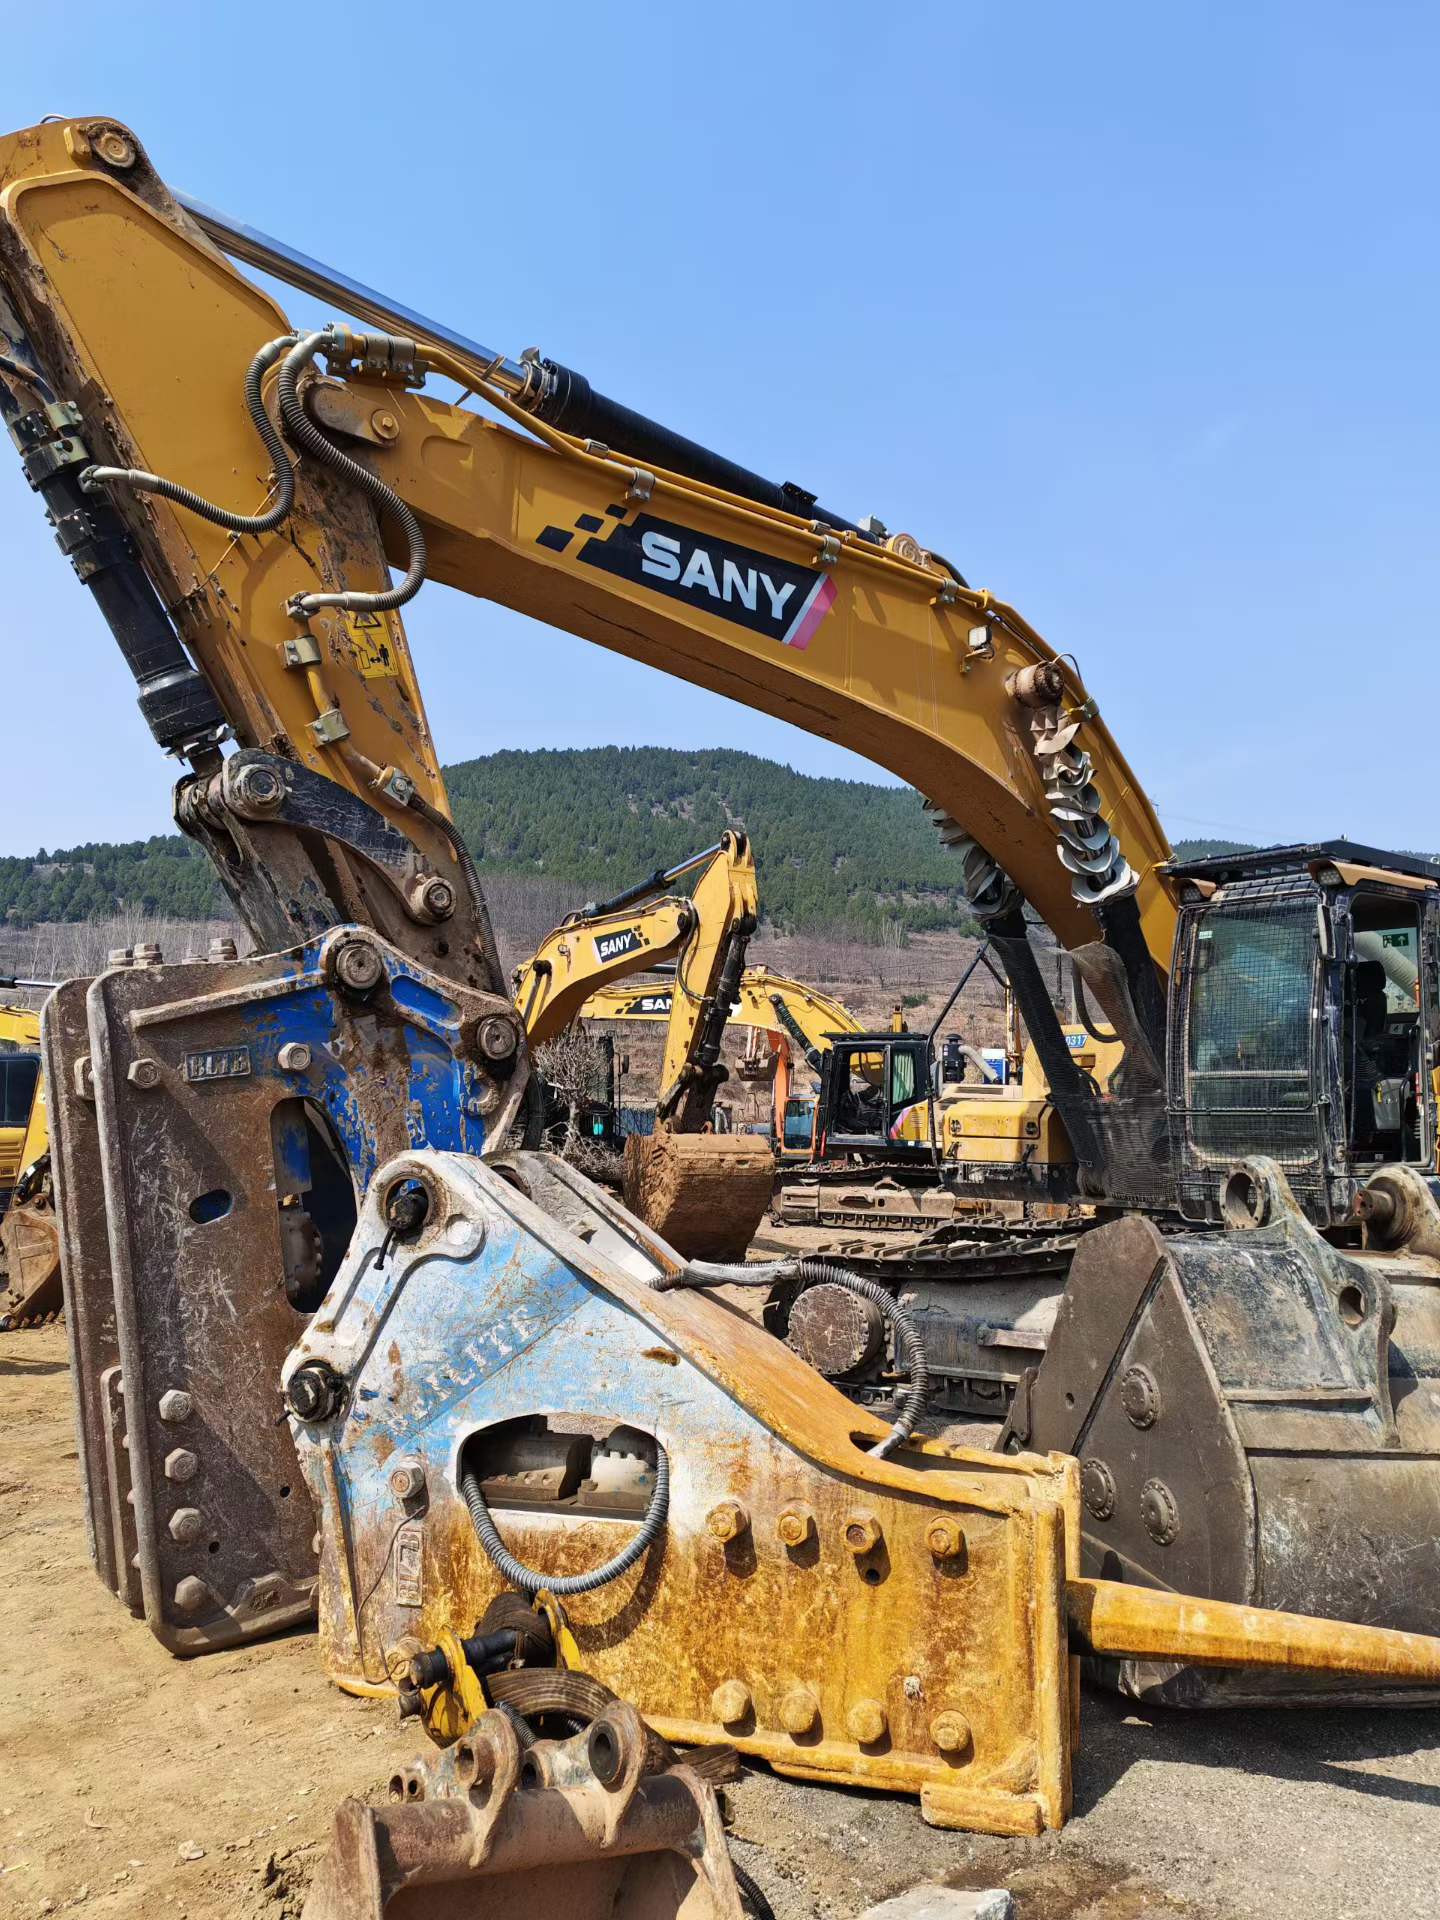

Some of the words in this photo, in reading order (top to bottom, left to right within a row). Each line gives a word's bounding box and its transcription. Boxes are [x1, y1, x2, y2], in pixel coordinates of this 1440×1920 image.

[641, 531, 797, 620] SANY
[601, 932, 632, 957] SANY
[641, 999, 672, 1010] SAN
